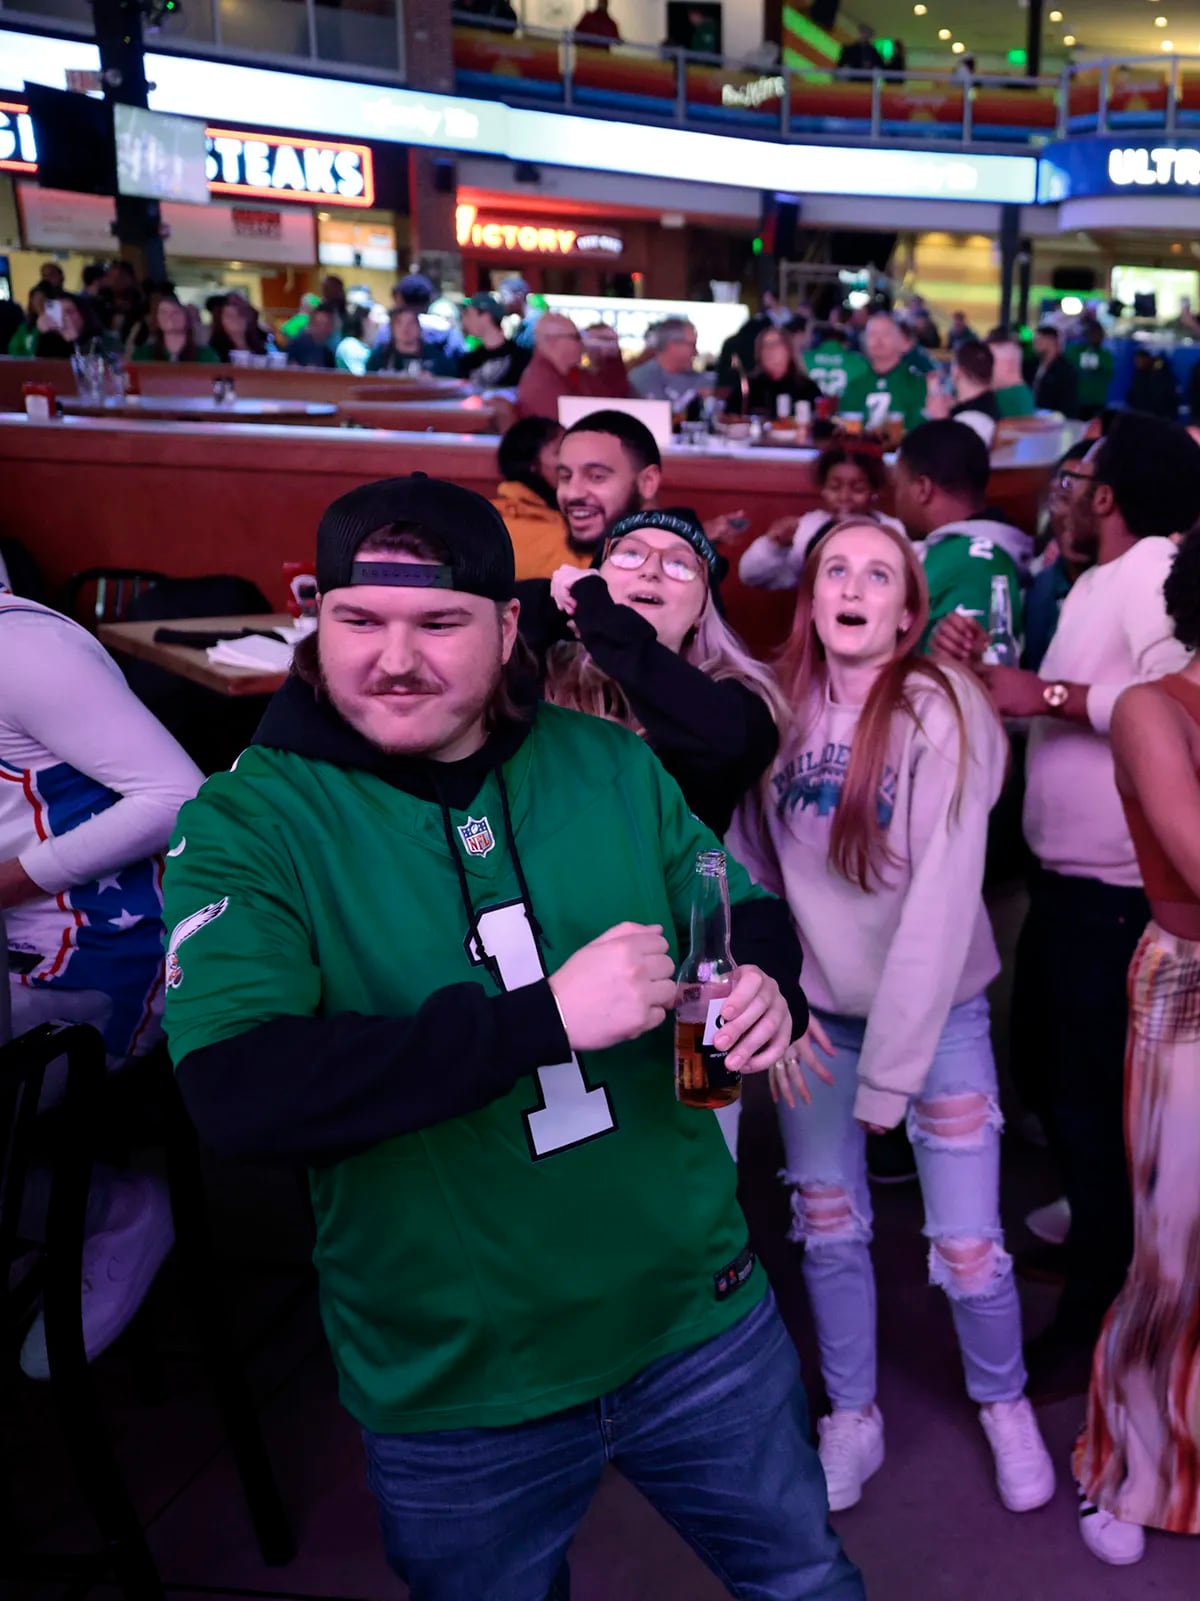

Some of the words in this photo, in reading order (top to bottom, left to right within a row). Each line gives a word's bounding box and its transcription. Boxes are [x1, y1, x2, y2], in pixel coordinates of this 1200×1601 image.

[456, 203, 576, 254] VICTORY
[466, 832, 491, 852] NFL
[464, 898, 618, 1161] 1
